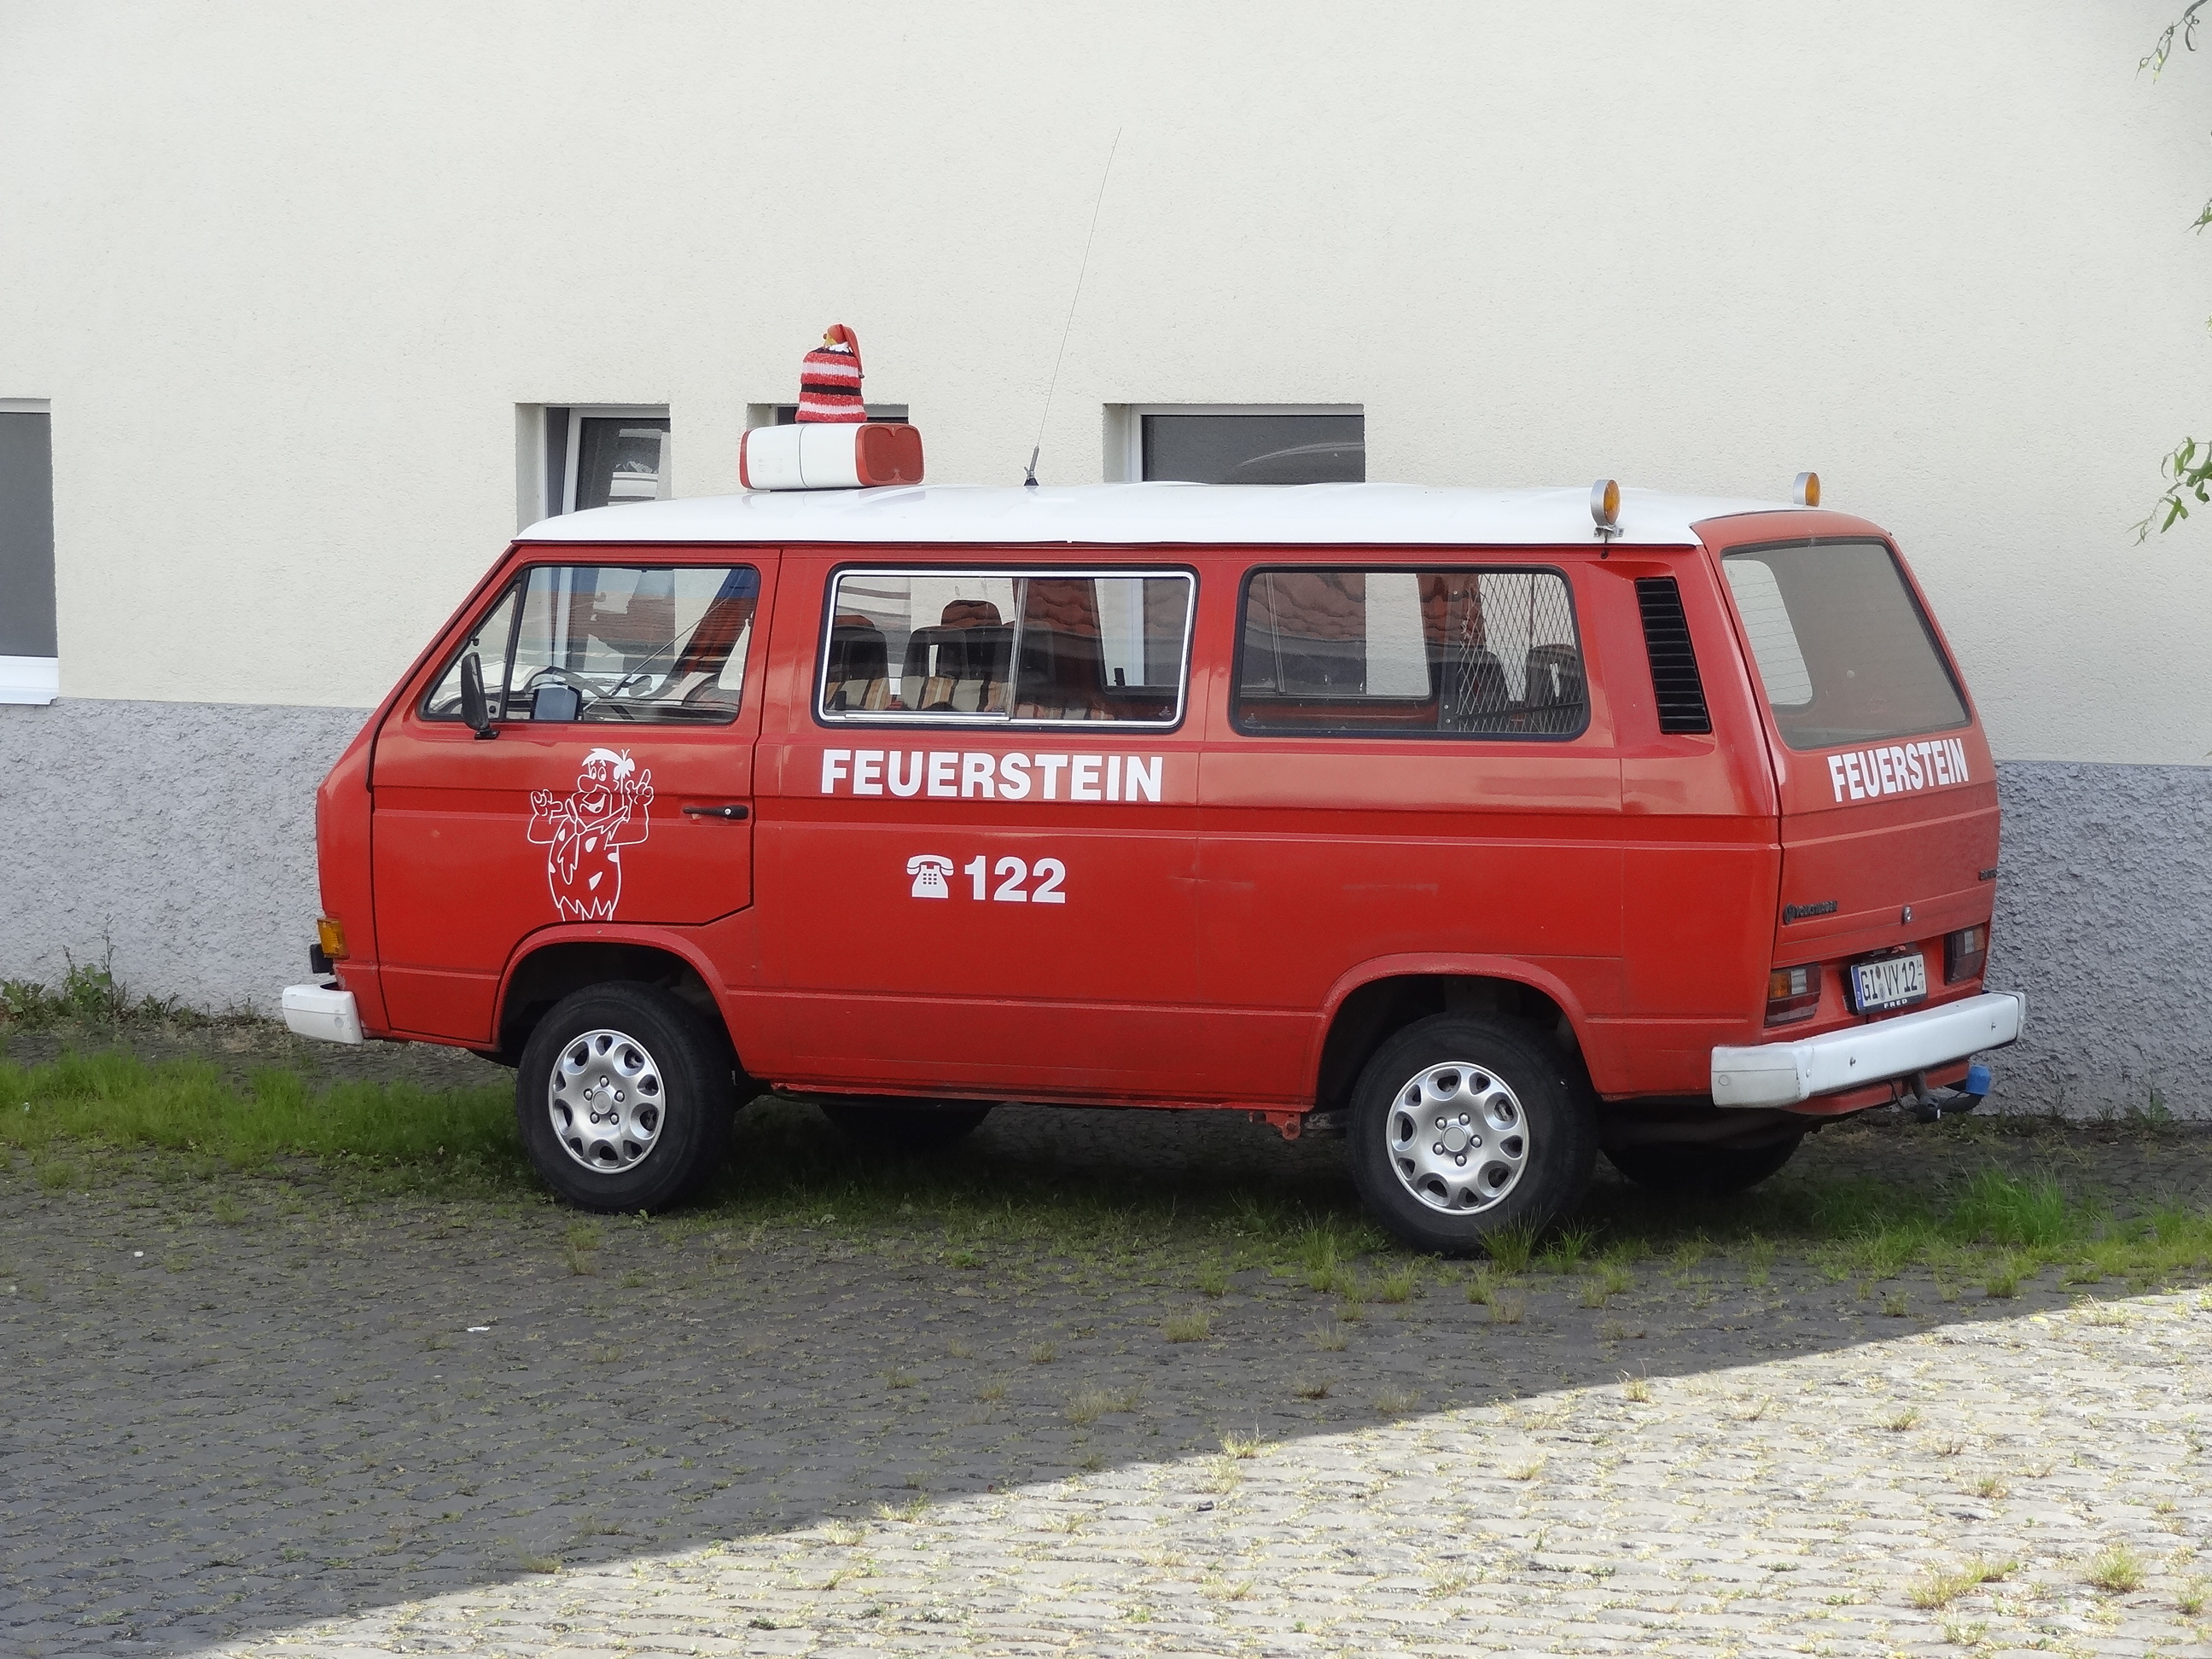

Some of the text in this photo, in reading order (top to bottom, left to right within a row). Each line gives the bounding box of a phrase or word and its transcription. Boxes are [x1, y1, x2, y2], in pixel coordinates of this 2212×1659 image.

[820, 749, 1164, 802] FEUERSTEIN
[1827, 737, 1969, 802] FEUERSTEIN
[963, 855, 1066, 904] 122
[1860, 961, 1918, 1001] GI VY 12
[1883, 998, 1908, 1009] FRED
